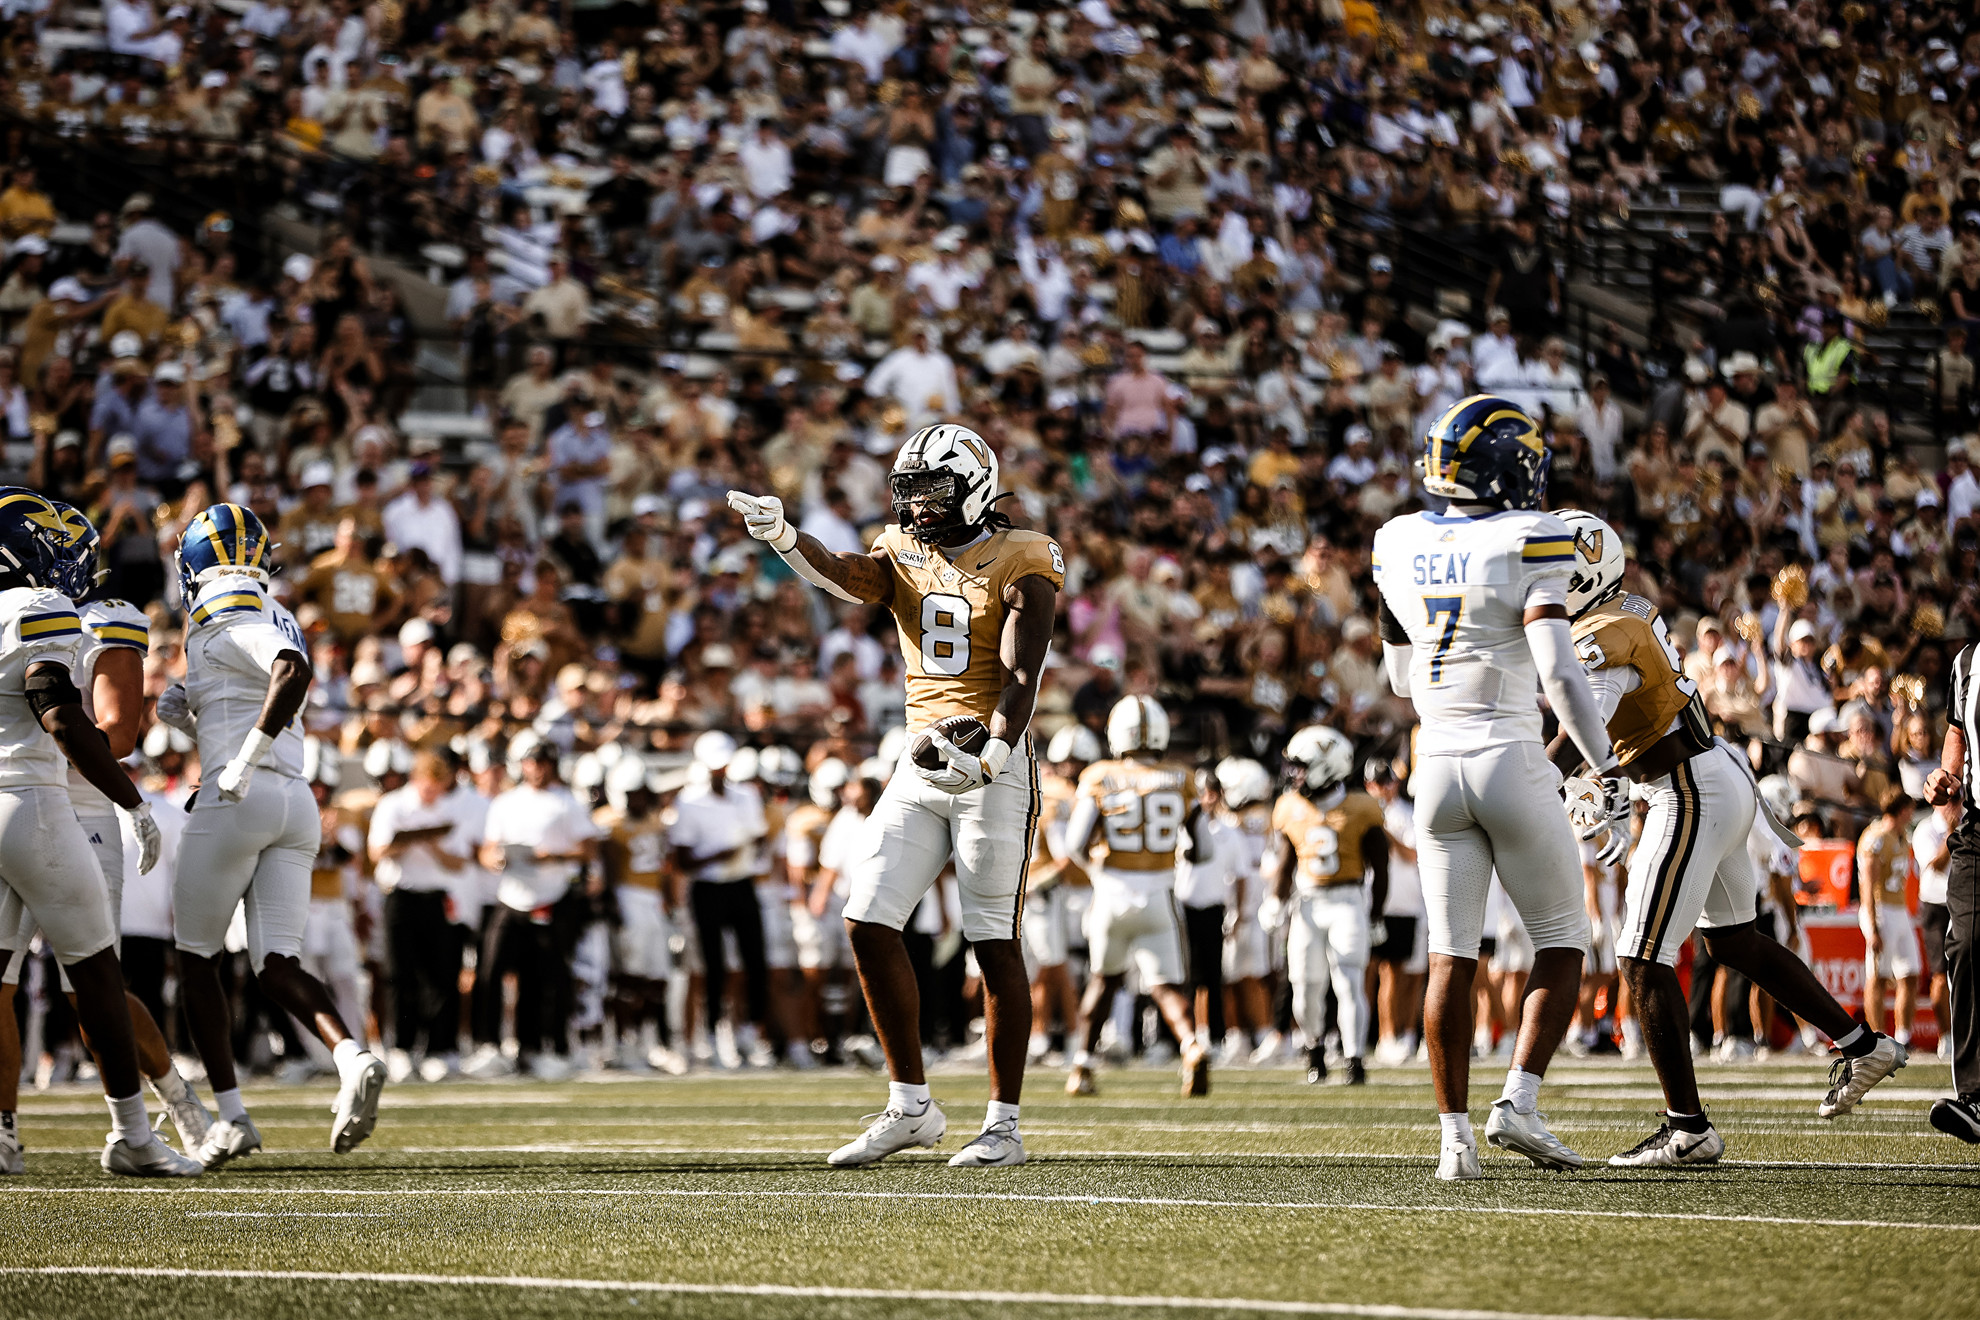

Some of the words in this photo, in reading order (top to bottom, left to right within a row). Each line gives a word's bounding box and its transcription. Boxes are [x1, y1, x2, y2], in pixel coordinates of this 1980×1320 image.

[1047, 541, 1065, 575] 8
[1413, 552, 1471, 585] SEAY
[920, 592, 972, 677] 8
[1421, 594, 1466, 685] 7
[1574, 632, 1606, 671] 5
[1103, 789, 1185, 853] 28
[1305, 826, 1340, 876] 3
